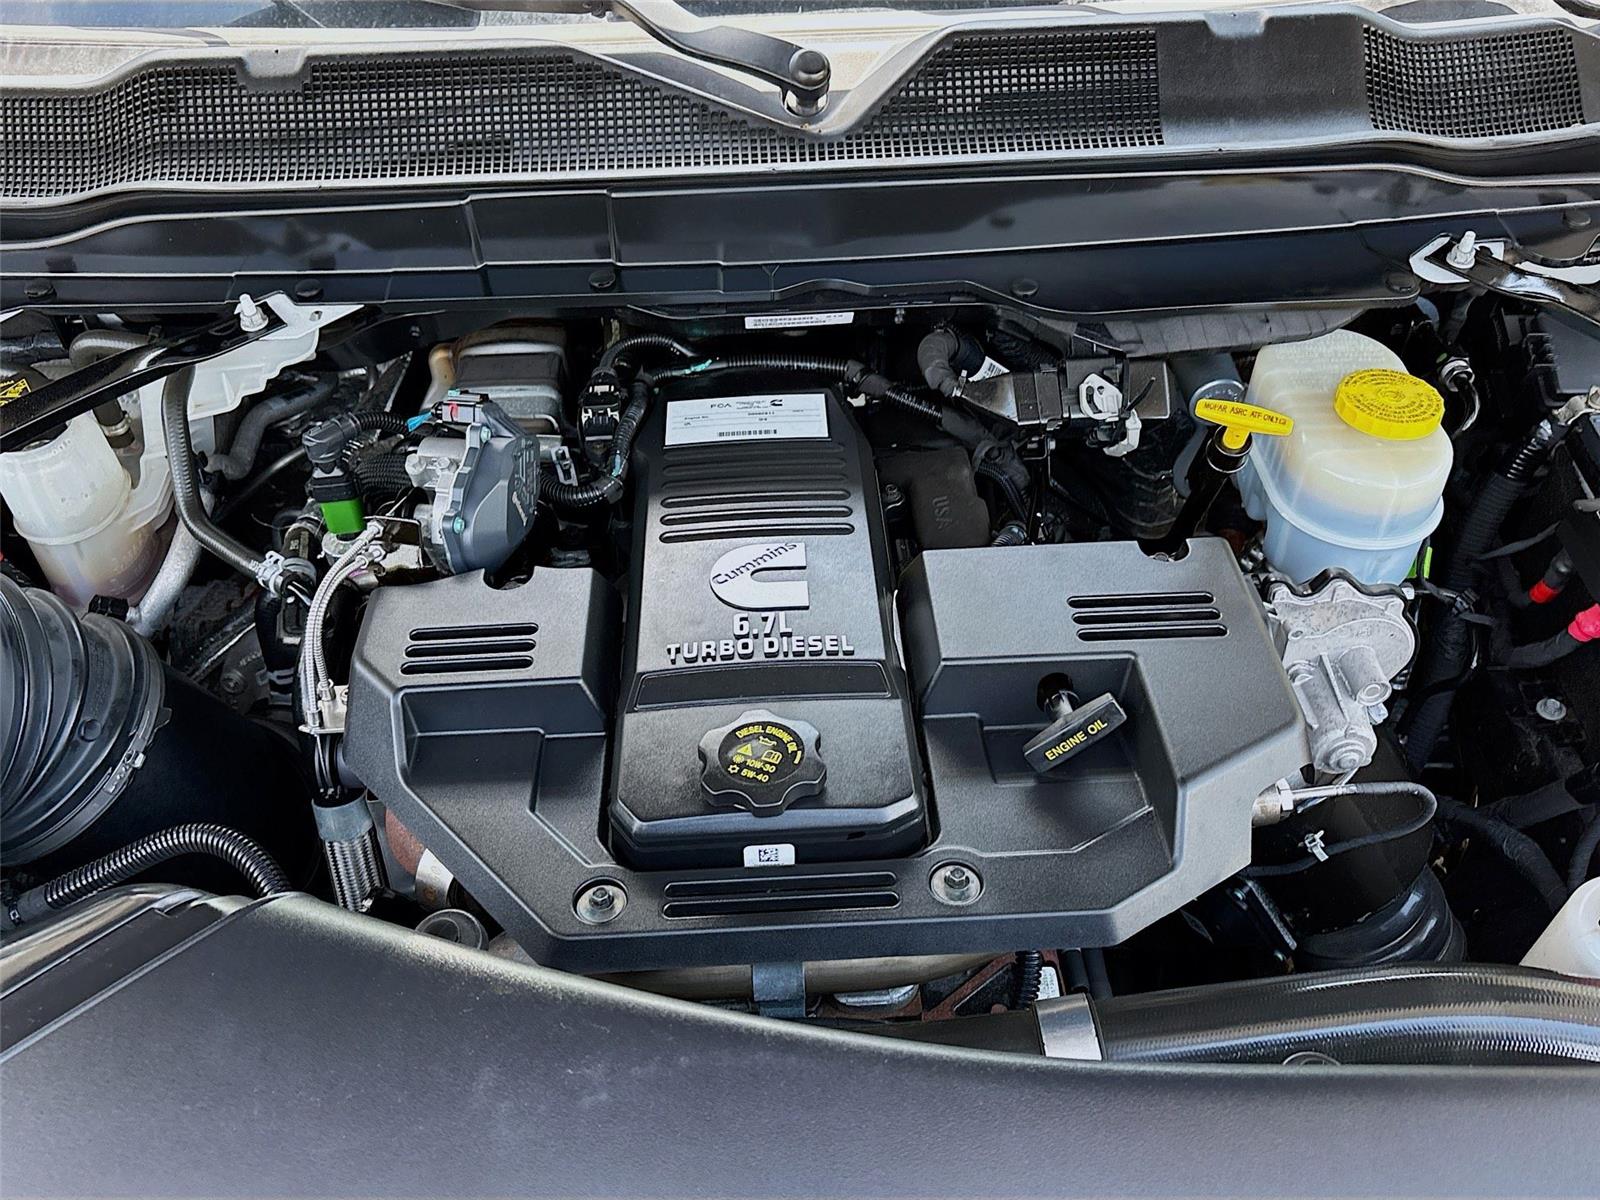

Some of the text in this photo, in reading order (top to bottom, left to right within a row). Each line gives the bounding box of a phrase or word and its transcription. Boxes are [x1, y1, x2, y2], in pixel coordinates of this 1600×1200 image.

[1204, 403, 1227, 412] MOPAR
[712, 543, 797, 585] Cummins
[733, 612, 793, 638] 6.7L
[666, 635, 854, 663] TURBO DIESEL
[735, 725, 798, 754] DIESEL ENGINE OIL
[1045, 719, 1108, 760] ENGINE OIL
[741, 768, 769, 783] 5W-40
[746, 759, 776, 773] 10W-30
